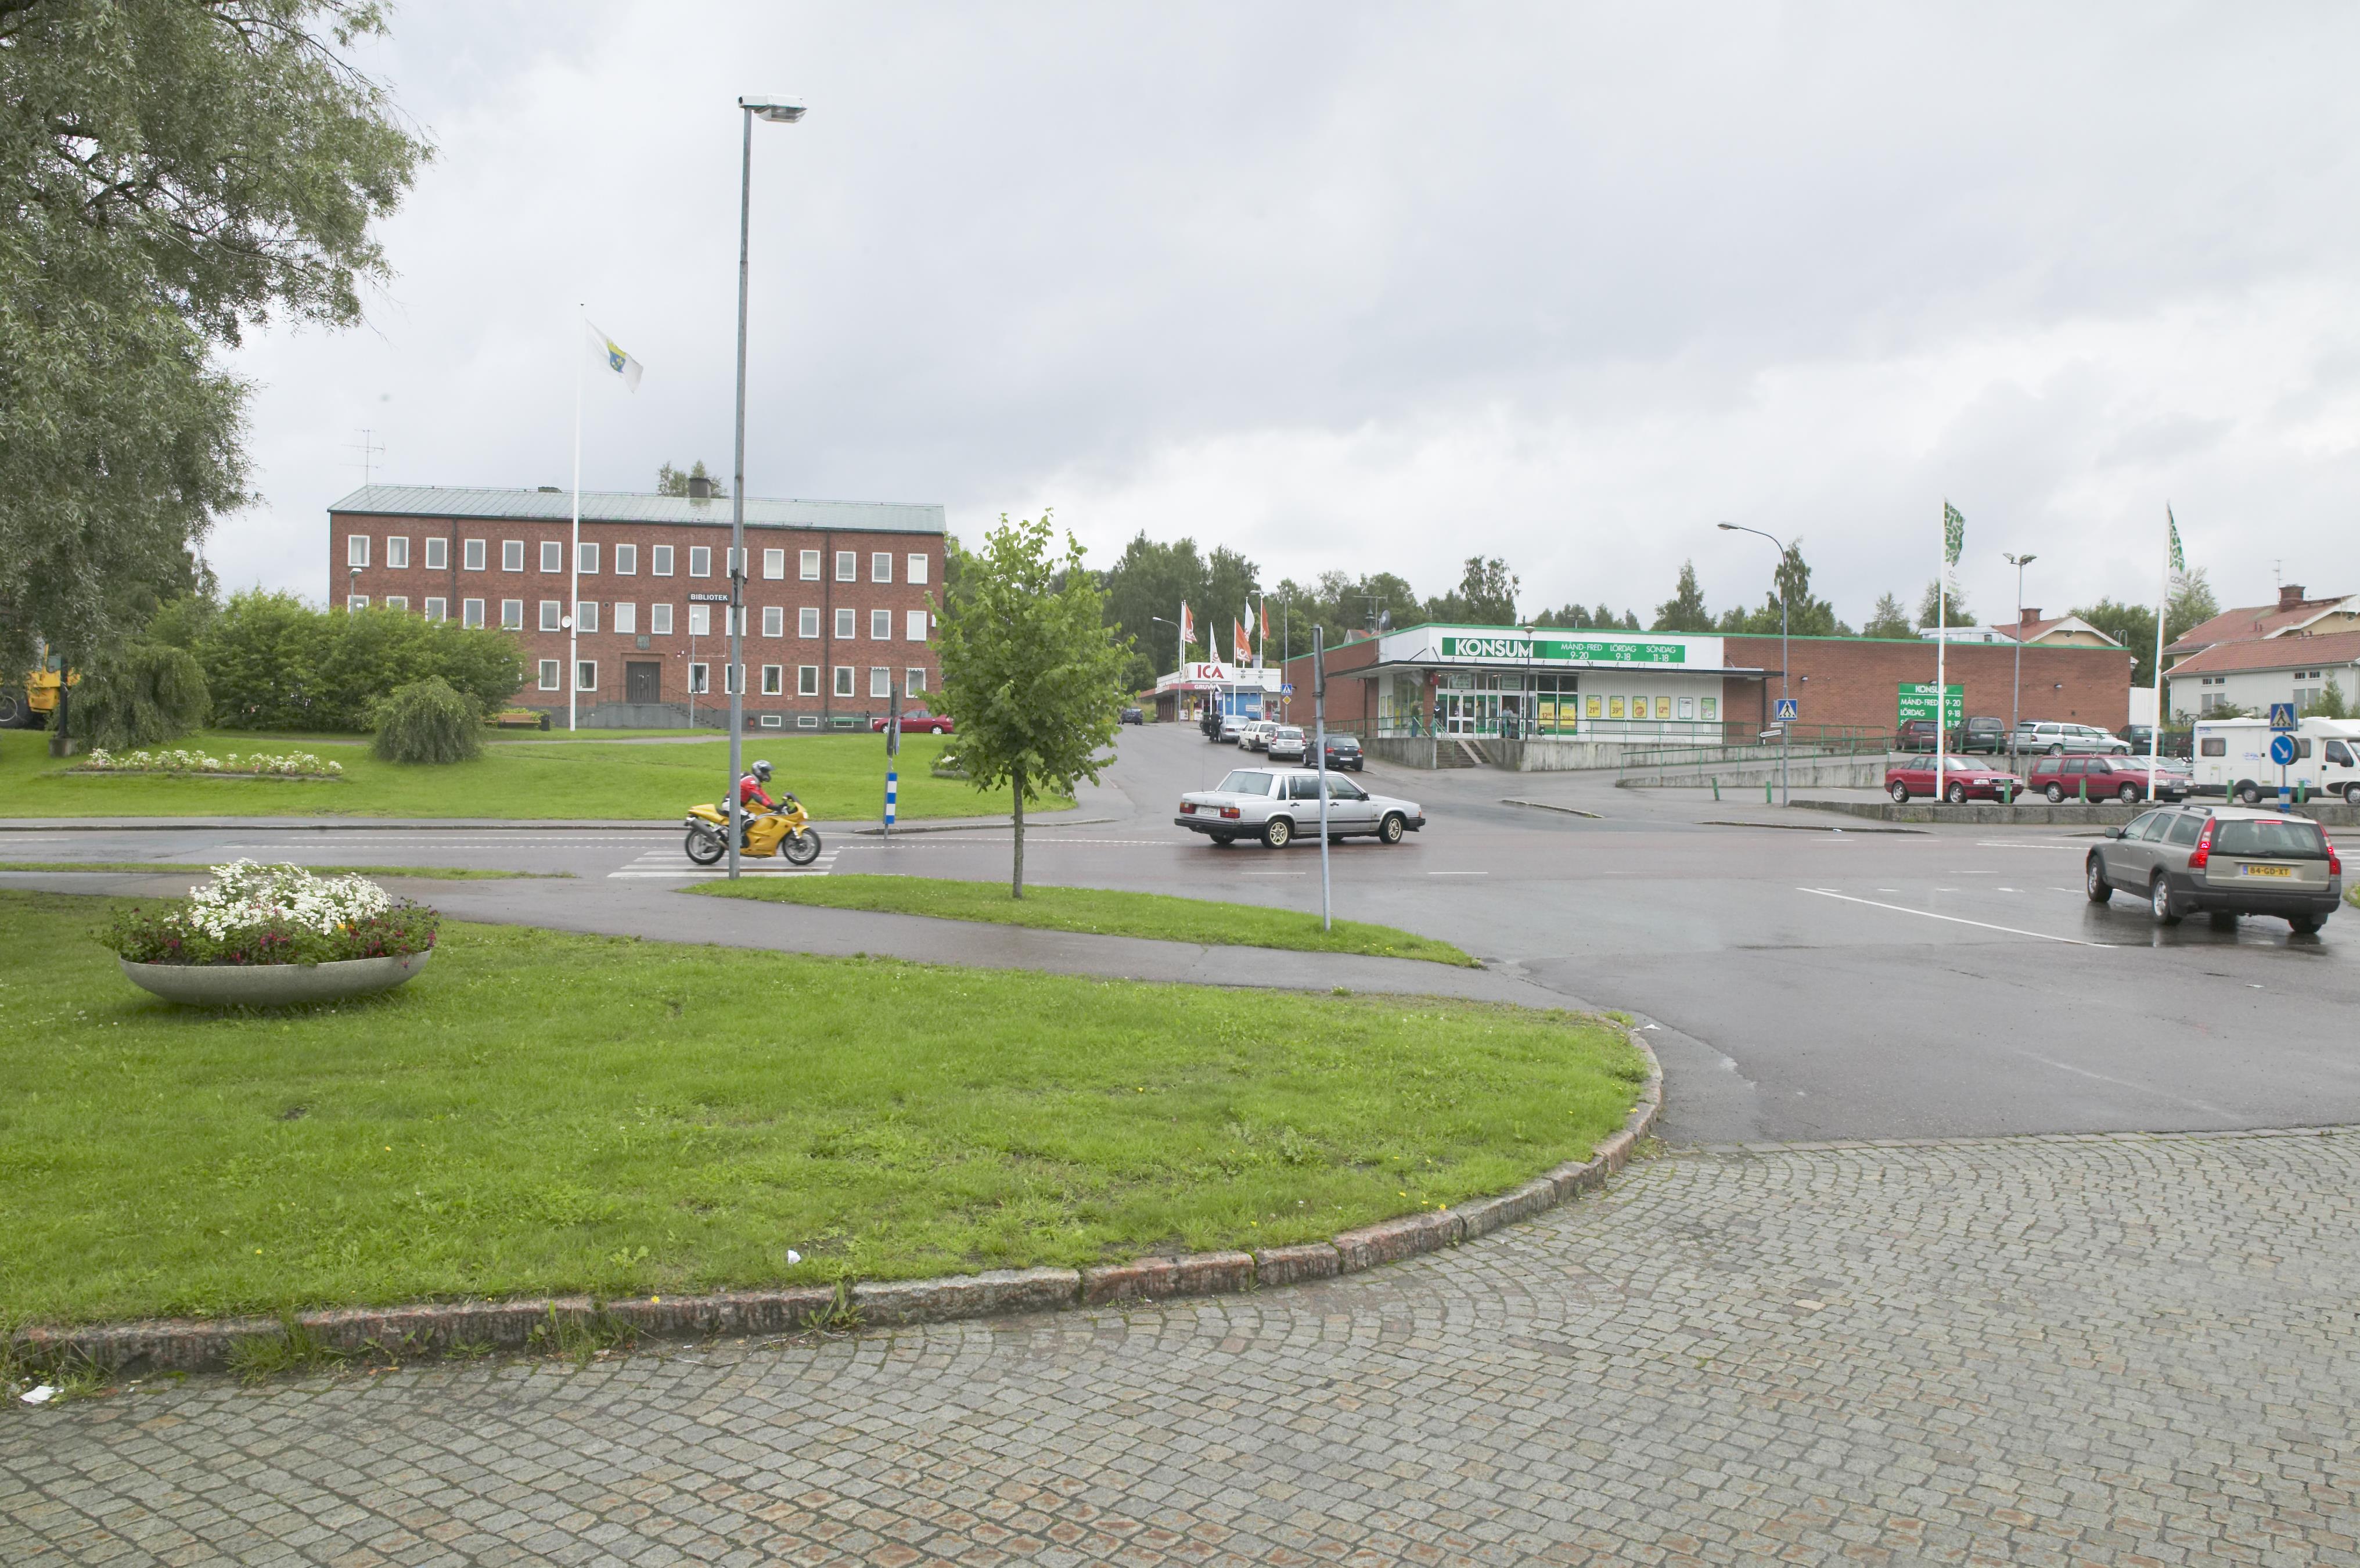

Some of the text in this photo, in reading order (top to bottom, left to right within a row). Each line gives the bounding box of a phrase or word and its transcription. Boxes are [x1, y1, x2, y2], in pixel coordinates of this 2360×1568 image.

[1455, 639, 1534, 657] KONSUM
[1610, 643, 1637, 652] LÖRDAG
[1646, 644, 1677, 654] SÖNDAG
[1570, 651, 1669, 662] 9-20 9-18 11-18
[1197, 664, 1224, 679] ICA
[1900, 708, 1926, 717] LÖRDAG
